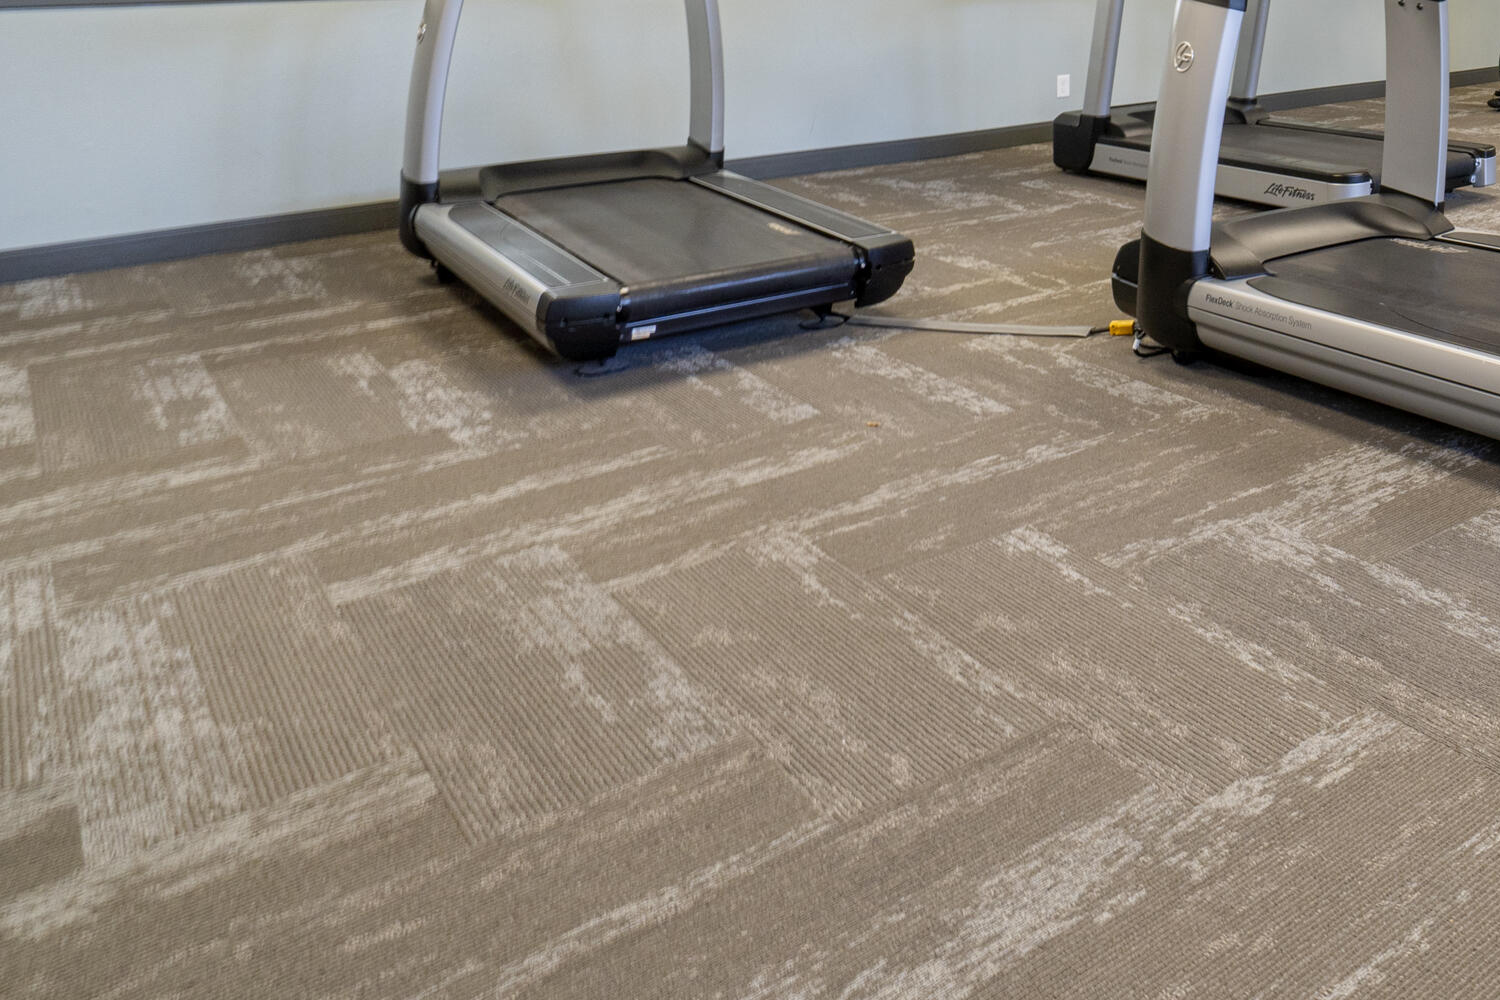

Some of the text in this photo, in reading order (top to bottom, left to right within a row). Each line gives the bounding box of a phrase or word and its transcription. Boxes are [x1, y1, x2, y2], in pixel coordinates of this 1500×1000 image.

[1205, 293, 1312, 330] FlexDeck Shock Absorption System
